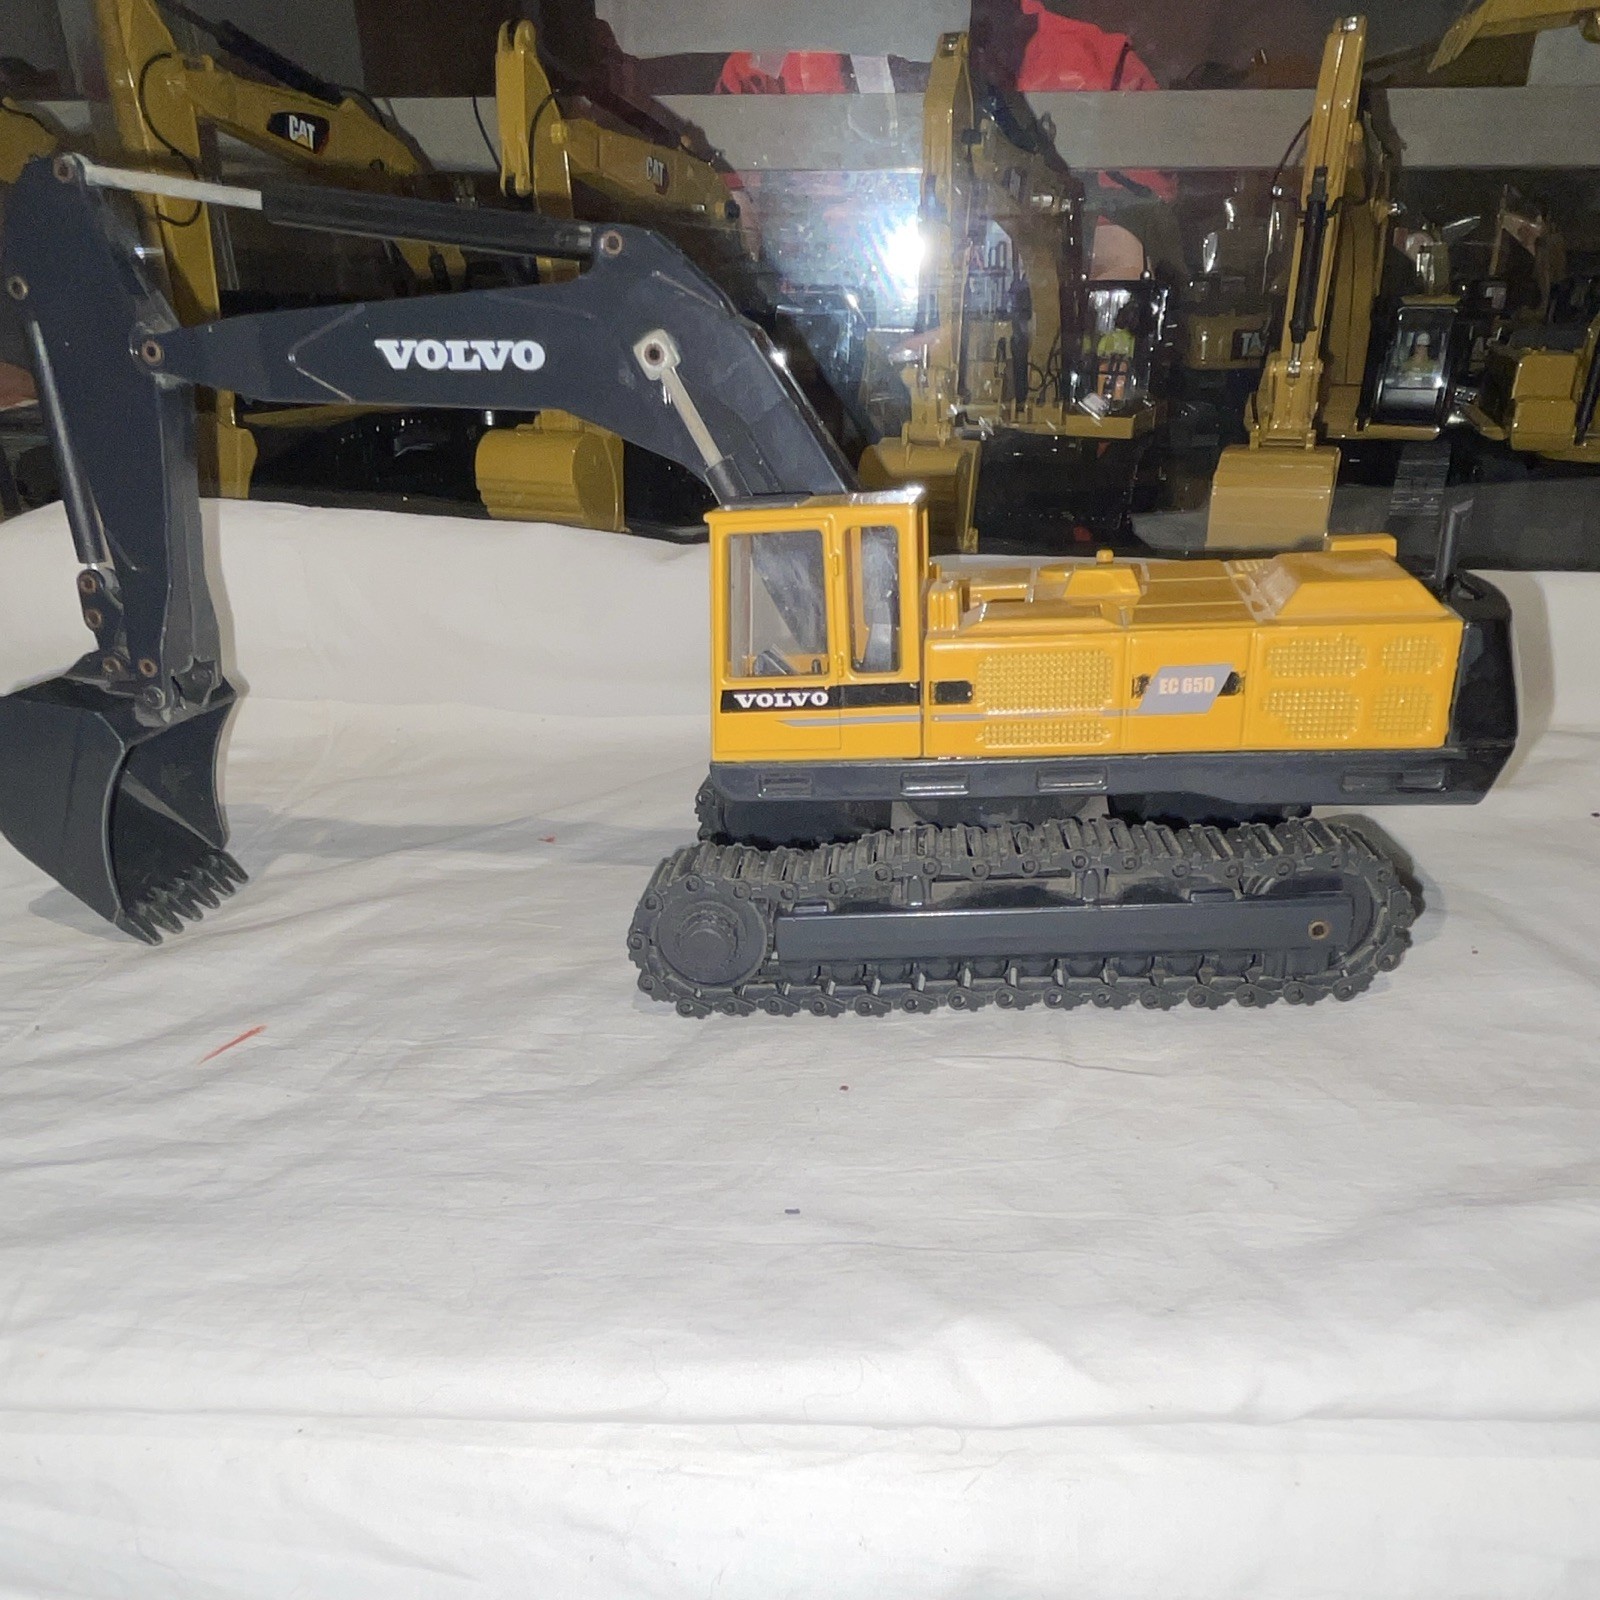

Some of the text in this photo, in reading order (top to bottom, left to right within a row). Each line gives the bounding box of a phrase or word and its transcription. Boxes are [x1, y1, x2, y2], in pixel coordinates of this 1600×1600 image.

[288, 114, 316, 151] CAT
[374, 339, 546, 371] VOLVO
[1159, 676, 1216, 695] EC 650
[733, 691, 829, 709] VOLVO
